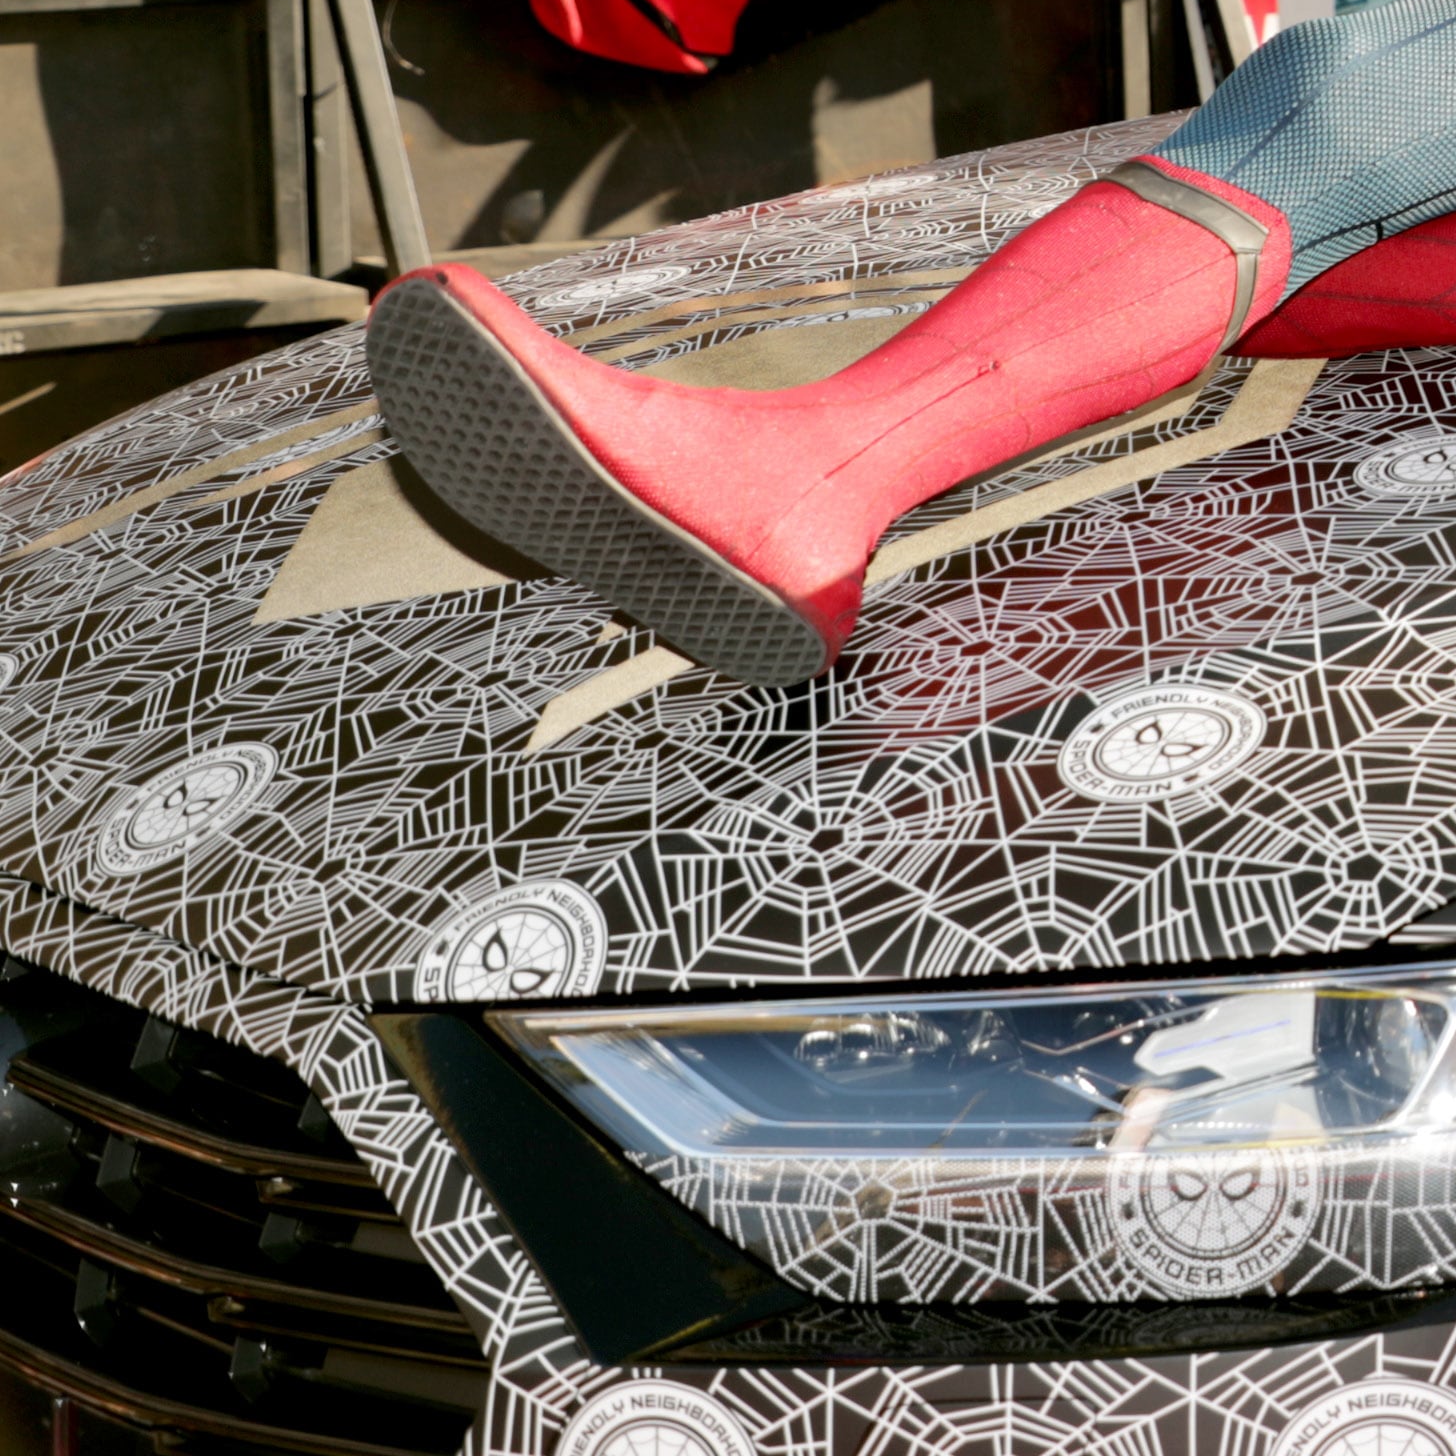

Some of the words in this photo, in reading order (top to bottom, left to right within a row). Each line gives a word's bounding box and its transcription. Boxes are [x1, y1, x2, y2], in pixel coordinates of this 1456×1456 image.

[1110, 692, 1209, 721] FRIENDLY
[1068, 738, 1173, 798] SPIDER-MAN
[453, 886, 547, 933] FRIENDLY
[1128, 1223, 1297, 1287] SPIDER-MAN
